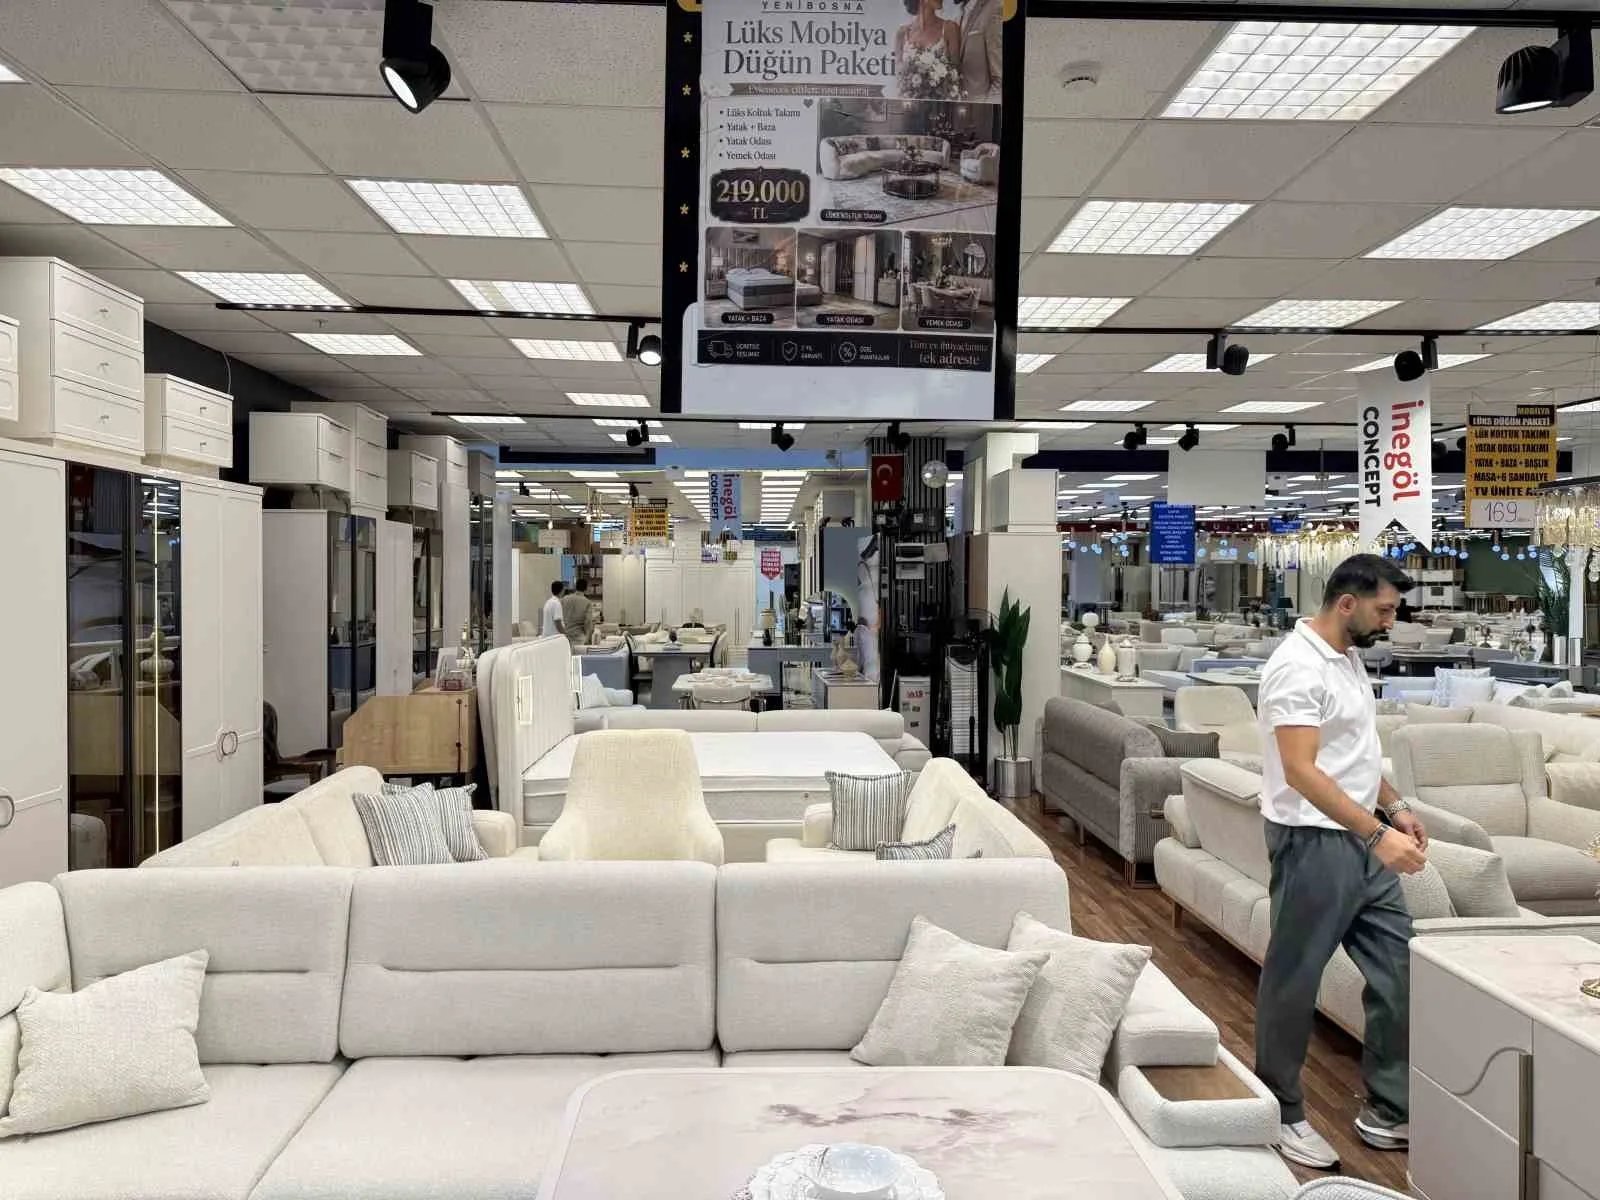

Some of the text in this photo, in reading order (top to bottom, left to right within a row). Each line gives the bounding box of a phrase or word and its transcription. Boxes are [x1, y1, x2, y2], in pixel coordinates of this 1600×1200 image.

[726, 20, 887, 51] Lüks Mobilya
[723, 49, 896, 81] Düğün Paketi
[716, 180, 805, 203] 219.000
[752, 207, 768, 219] TL
[1363, 406, 1381, 507] CONCEPT
[1384, 400, 1424, 502] inegöl
[1474, 486, 1488, 496] TV
[1491, 485, 1523, 496] ÜNİTE
[1508, 472, 1549, 481] SANDALYE
[710, 473, 719, 520] CONCEPT
[720, 473, 740, 520] inegöl
